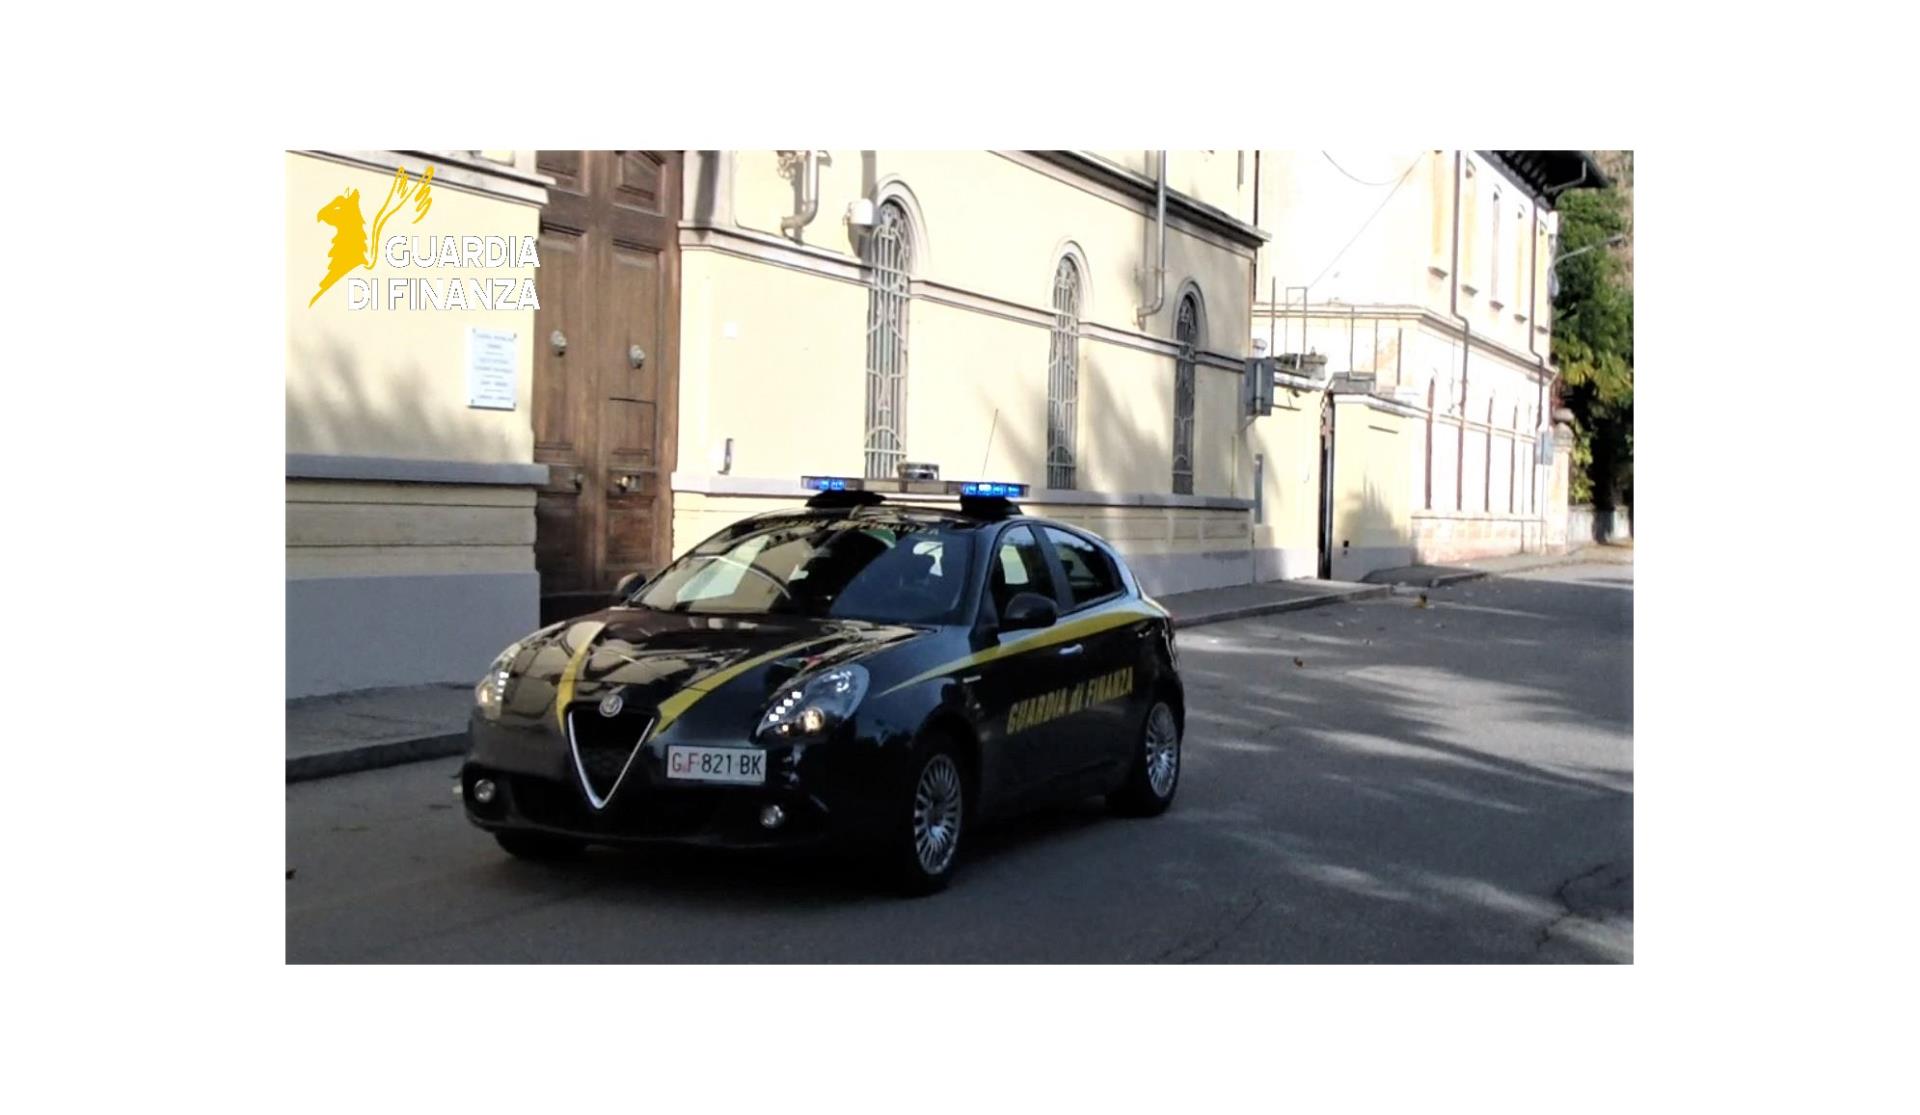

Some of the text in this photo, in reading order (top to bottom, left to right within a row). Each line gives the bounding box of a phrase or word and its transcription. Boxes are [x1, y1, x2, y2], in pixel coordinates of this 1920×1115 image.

[1007, 687, 1068, 735] GUARDIA
[1085, 666, 1133, 709] FINANZA
[701, 753, 733, 775] 821
[740, 754, 762, 775] BK
